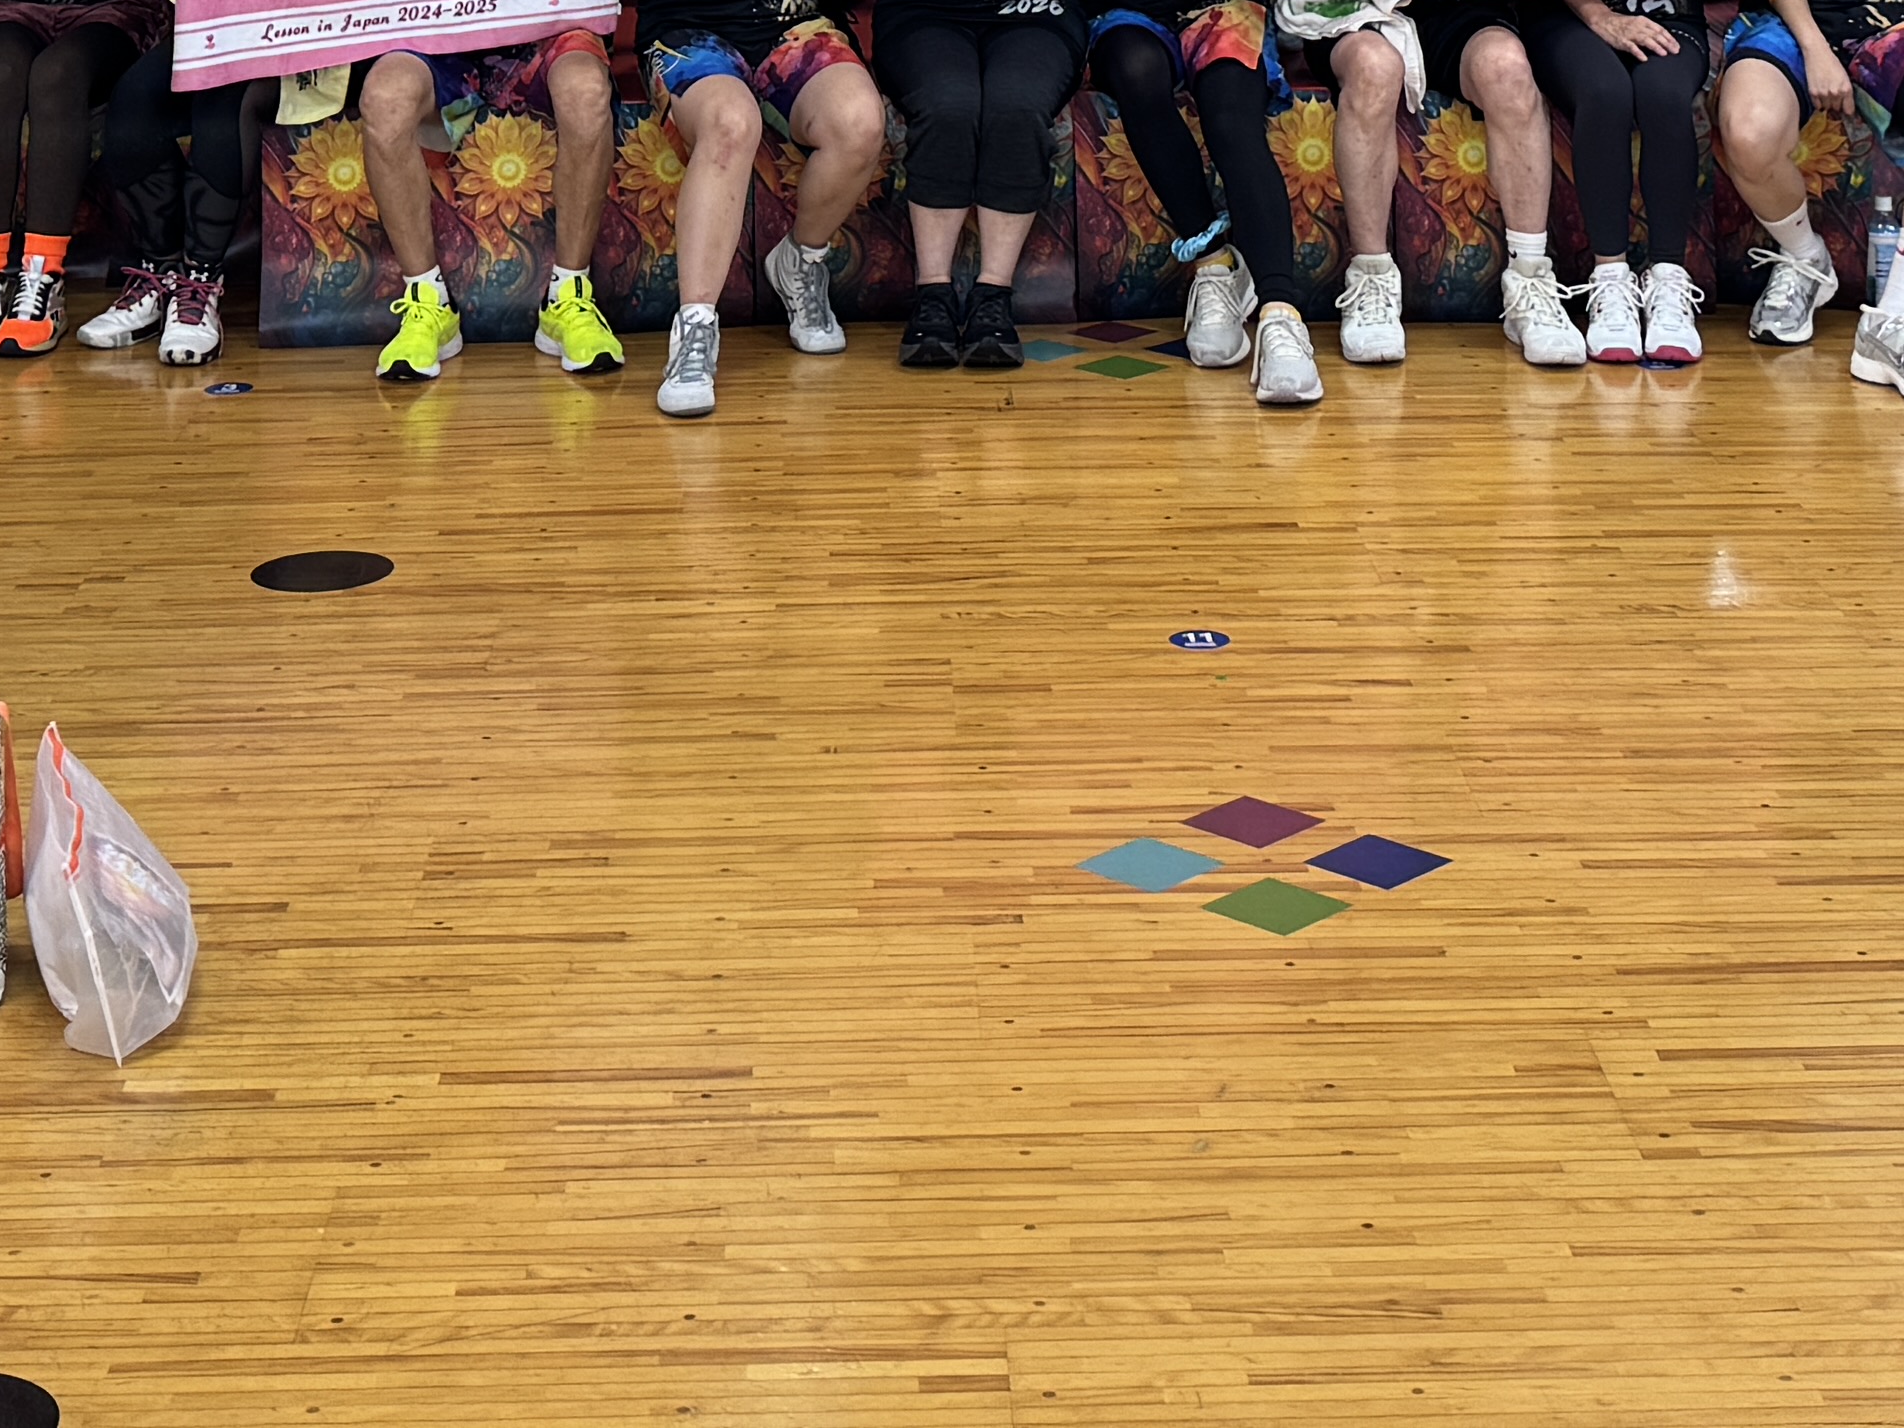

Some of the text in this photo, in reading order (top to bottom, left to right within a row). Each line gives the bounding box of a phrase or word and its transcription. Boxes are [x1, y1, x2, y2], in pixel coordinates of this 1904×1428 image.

[261, 22, 310, 42] Lesson
[317, 17, 333, 33] in
[340, 13, 390, 34] Japan
[1182, 632, 1213, 643] 11
